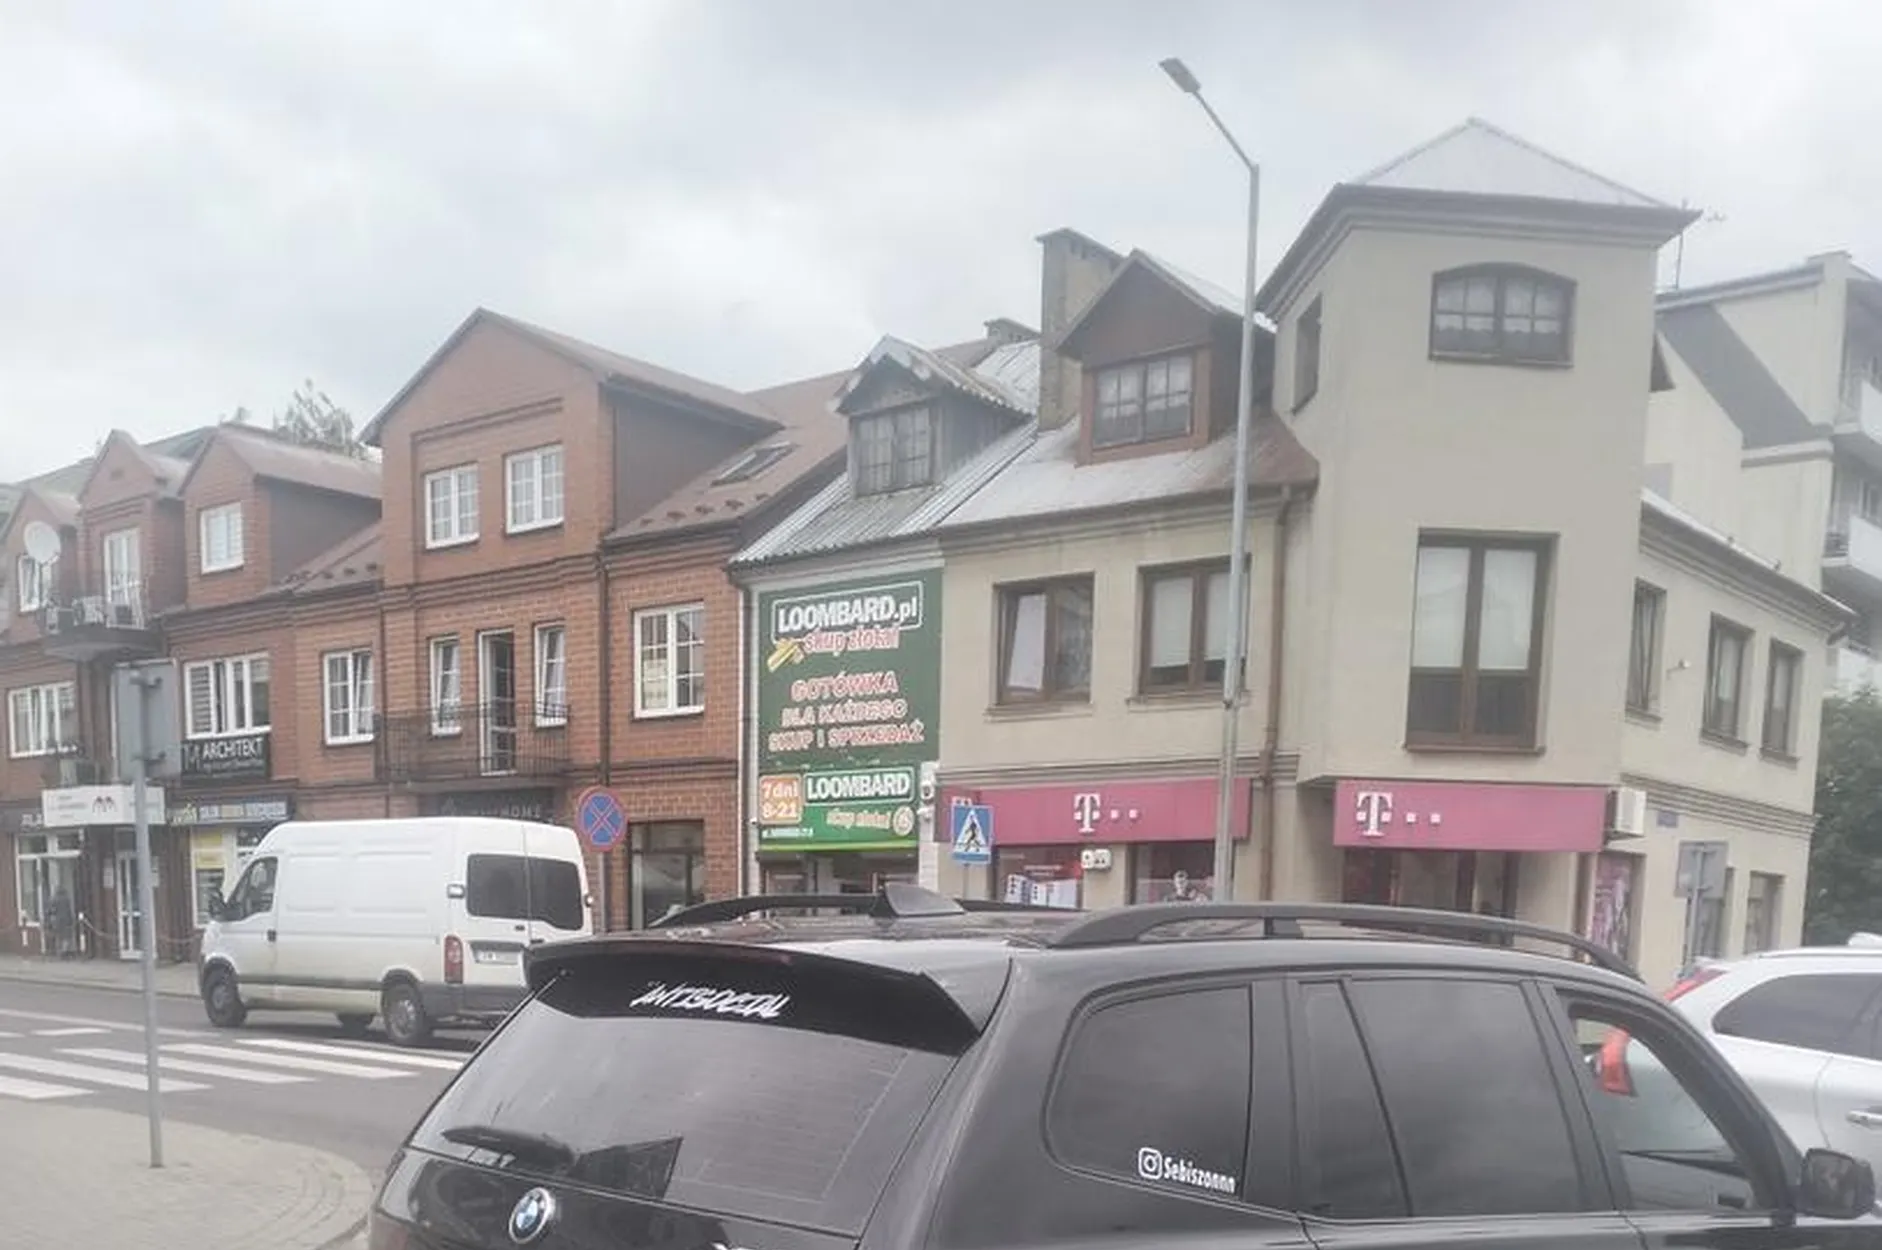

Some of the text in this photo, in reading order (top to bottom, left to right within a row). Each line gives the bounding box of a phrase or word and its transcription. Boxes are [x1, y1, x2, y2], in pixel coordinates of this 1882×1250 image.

[777, 595, 917, 633] LOOMBARD.pl
[791, 670, 899, 702] GOTÓWKA
[202, 737, 264, 760] ARCHITEKT
[807, 772, 910, 799] LOOMBARD
